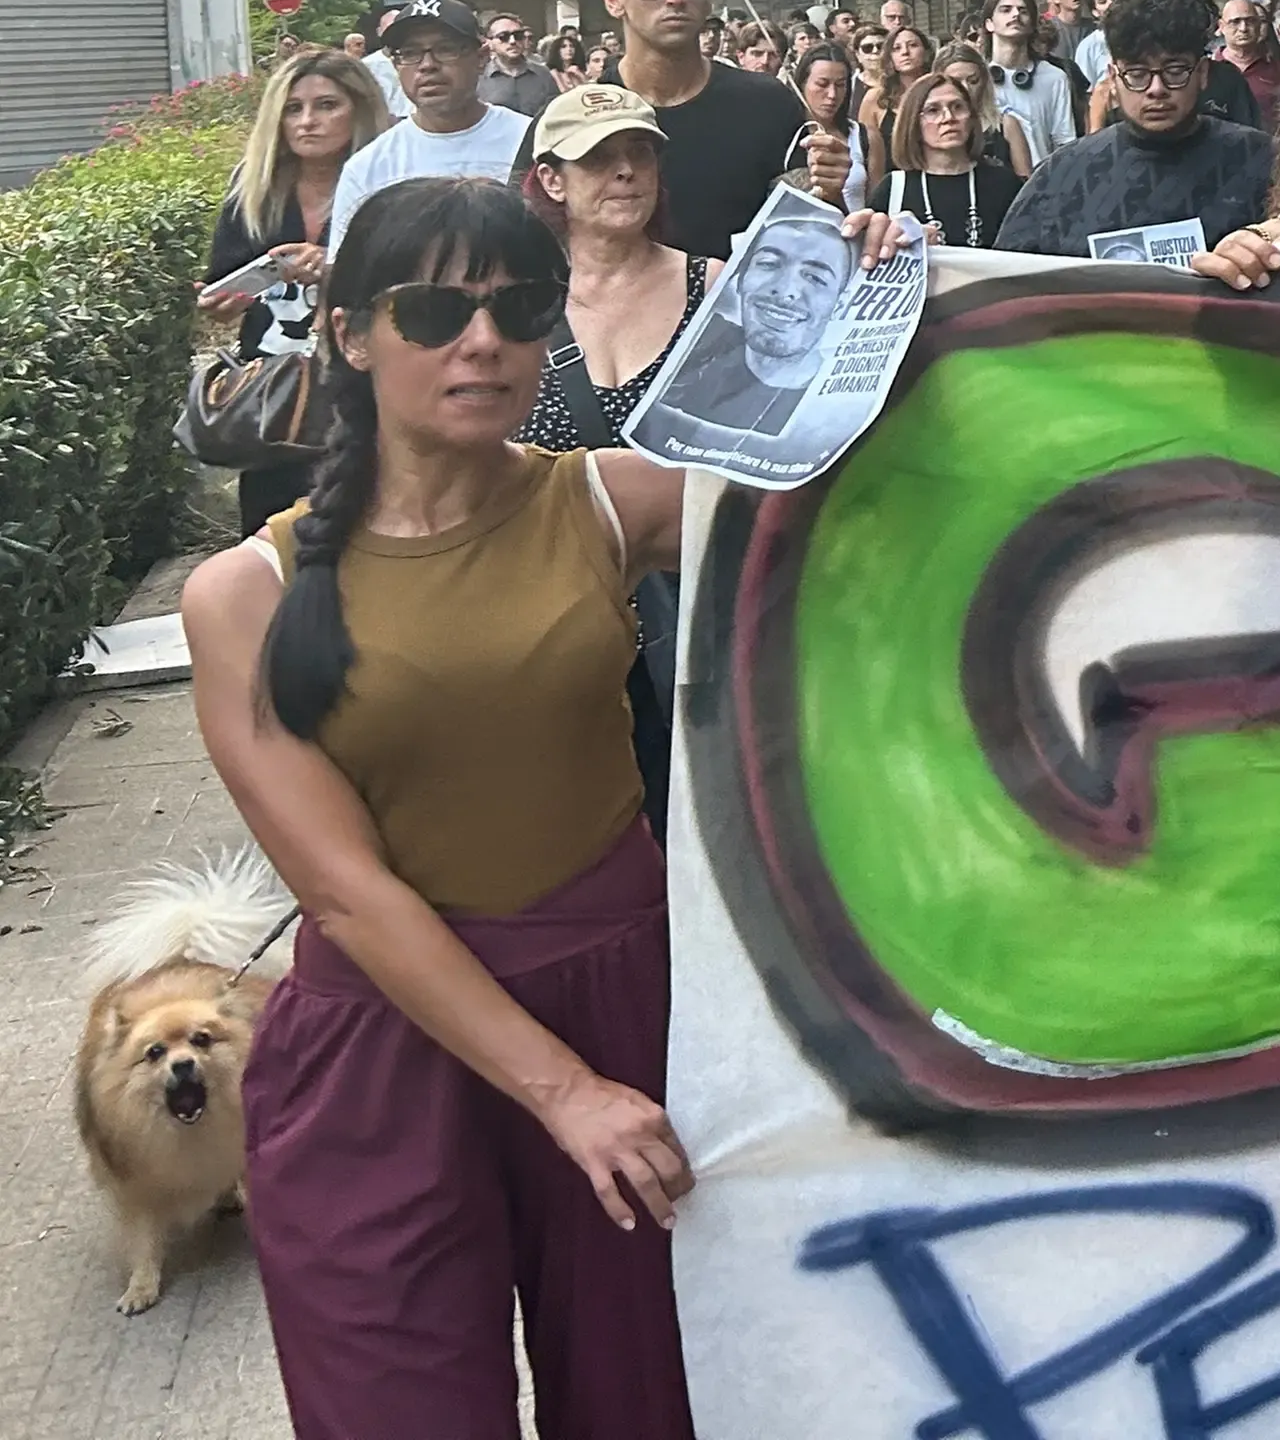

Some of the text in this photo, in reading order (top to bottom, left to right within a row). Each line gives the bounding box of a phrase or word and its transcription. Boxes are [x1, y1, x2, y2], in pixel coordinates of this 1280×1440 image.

[1149, 235, 1199, 258] GIUSTIZIA
[840, 283, 903, 321] PER
[844, 327, 862, 341] IN
[834, 341, 847, 357] E
[817, 379, 831, 396] E
[664, 436, 682, 453] Per
